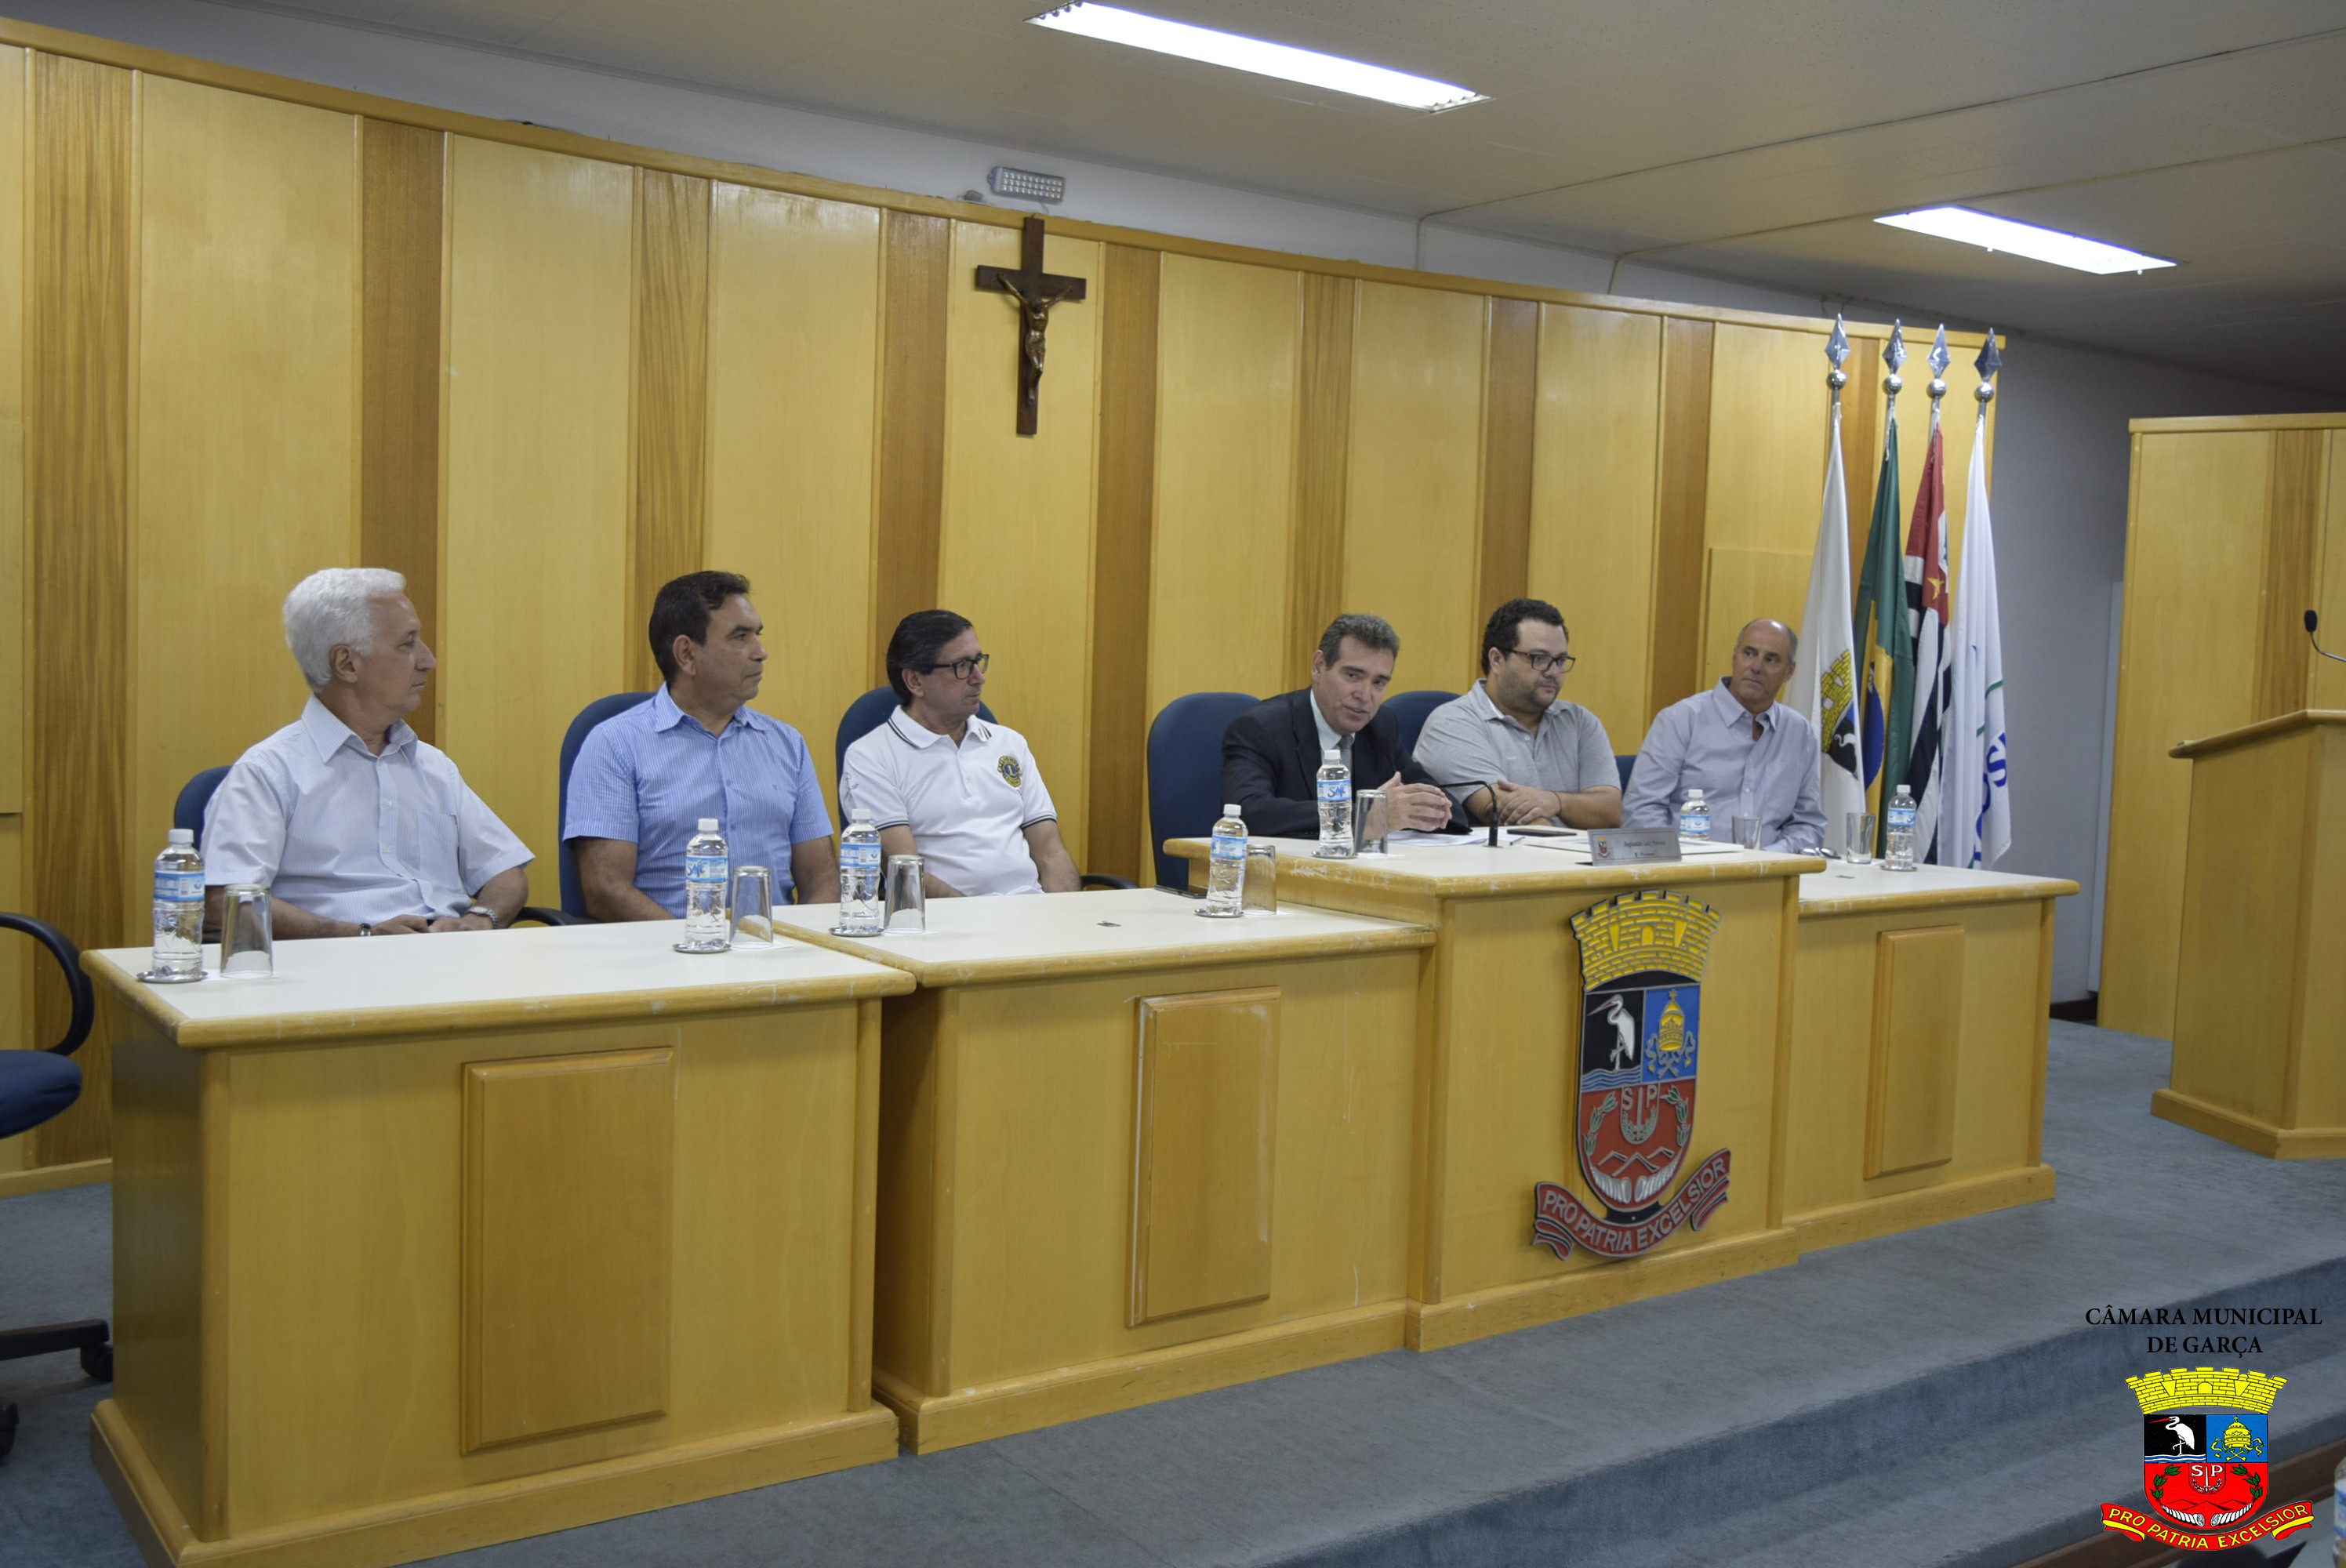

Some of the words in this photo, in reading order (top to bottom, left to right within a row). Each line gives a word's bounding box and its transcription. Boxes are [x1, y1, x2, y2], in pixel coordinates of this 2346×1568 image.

[1542, 1190, 1578, 1224] PRO
[1574, 1222, 1632, 1252] PATRIA
[1636, 1157, 1727, 1250] EXCELSIOR
